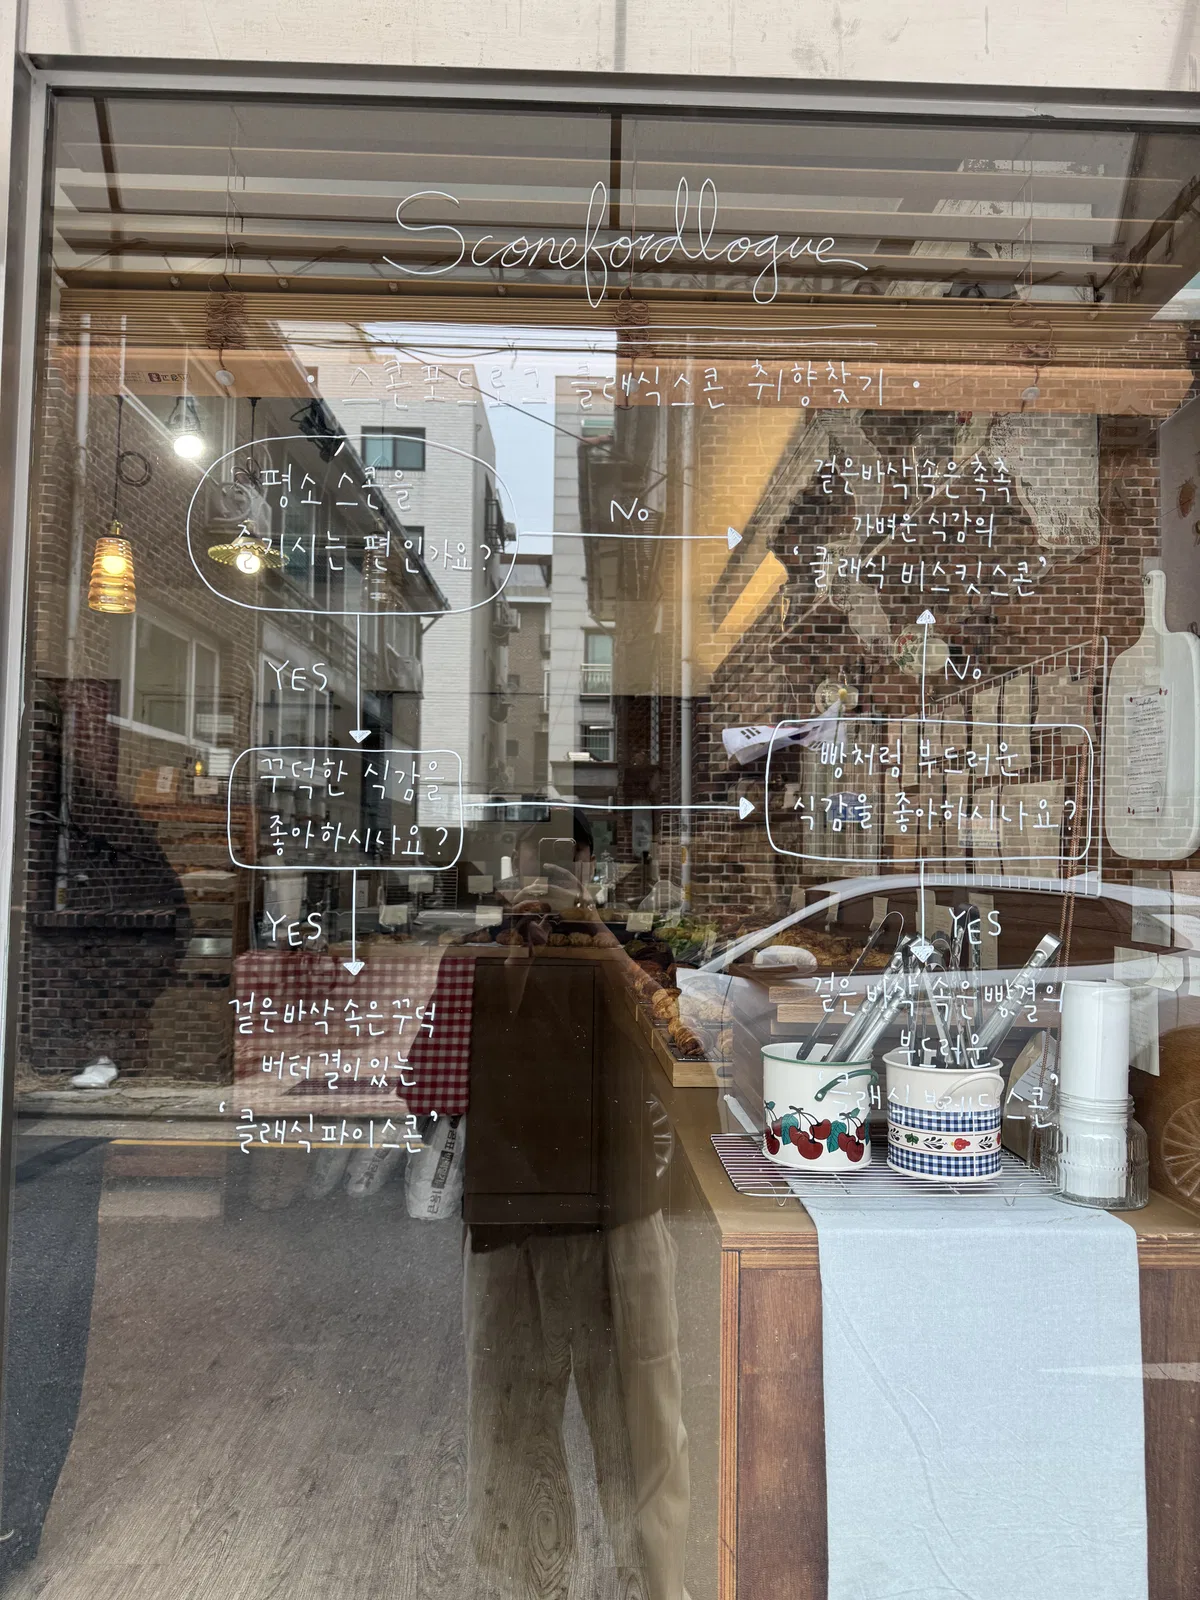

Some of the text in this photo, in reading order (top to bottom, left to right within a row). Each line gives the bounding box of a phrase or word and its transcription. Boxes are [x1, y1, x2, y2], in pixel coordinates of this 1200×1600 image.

[342, 360, 547, 411] 스콘포드로그
[748, 359, 884, 406] 취향찾기
[260, 463, 413, 511] 평소 스콘을
[610, 499, 649, 523] No
[852, 510, 994, 547] 가벼운 식감의
[363, 531, 493, 573] 편인가요?
[268, 660, 328, 691] YES
[944, 655, 982, 680] No
[820, 738, 1019, 778] 빵처럼 부드러운
[260, 758, 445, 801] 꾸덕한 식감을
[793, 791, 1077, 832] 식감을 좋아하시나요?
[270, 815, 449, 856] 좋아하시나요?
[266, 911, 322, 946] YES
[949, 907, 1002, 944] YES
[932, 977, 977, 1020] 속은
[262, 1049, 417, 1089] 버터 결이 있는
[898, 1030, 991, 1068] 부드러운
